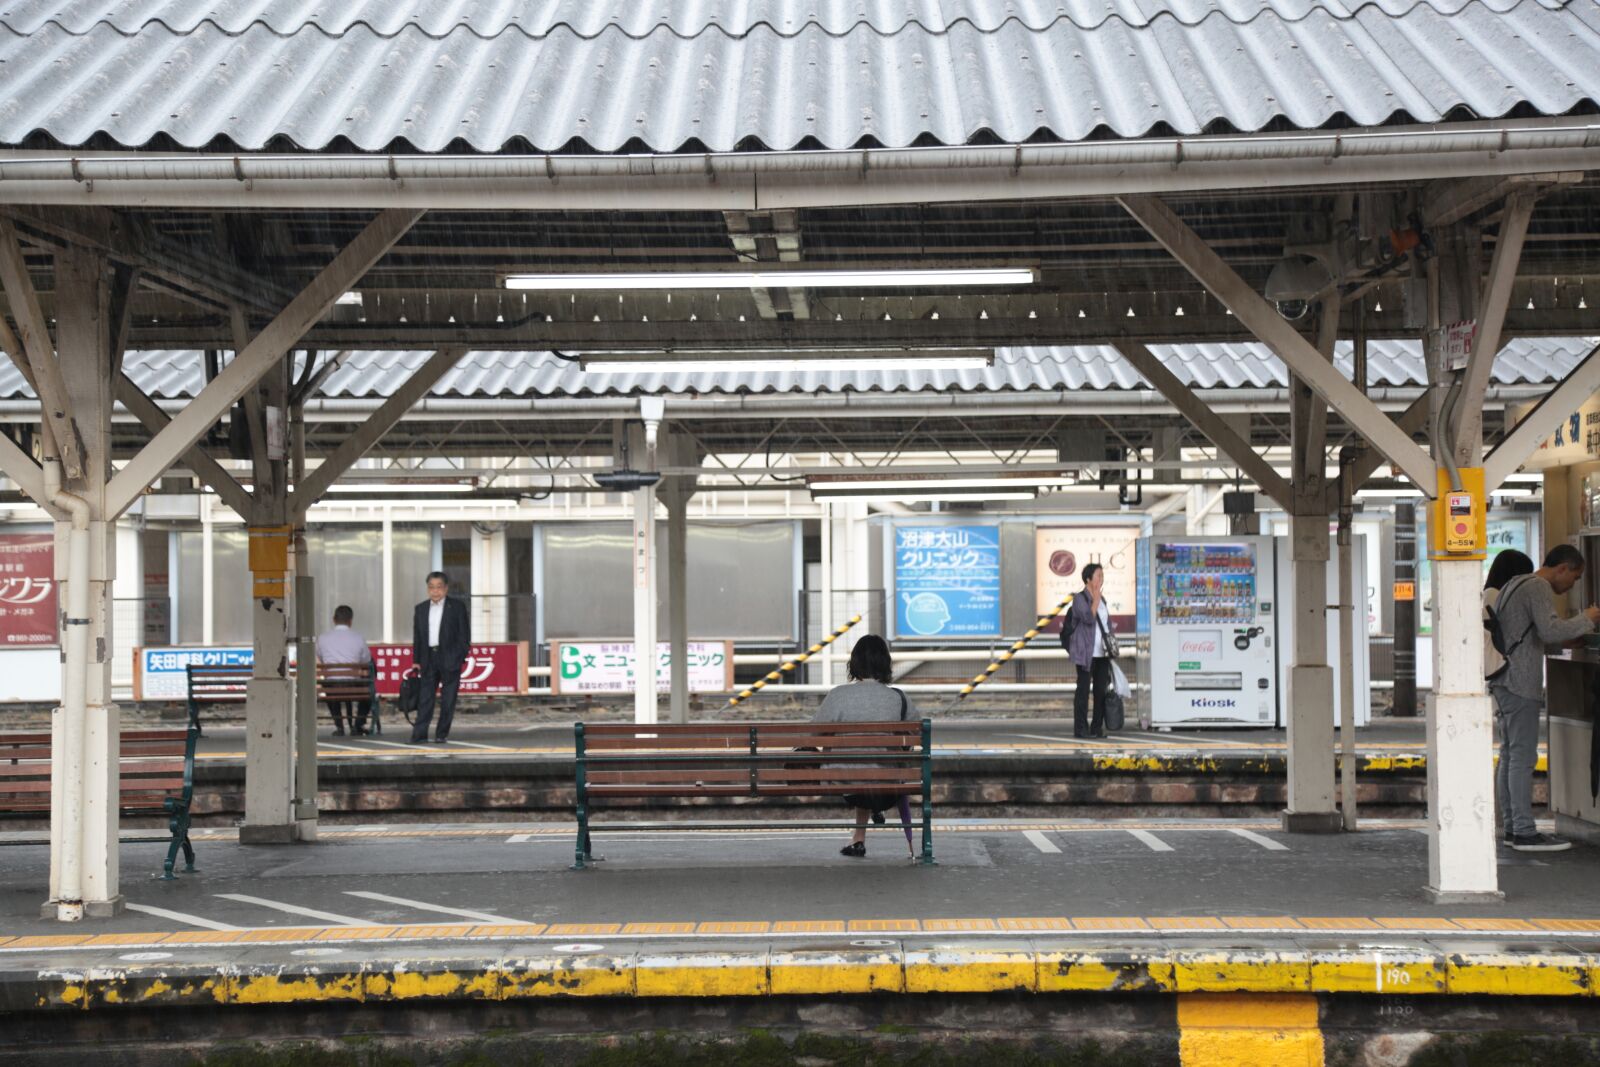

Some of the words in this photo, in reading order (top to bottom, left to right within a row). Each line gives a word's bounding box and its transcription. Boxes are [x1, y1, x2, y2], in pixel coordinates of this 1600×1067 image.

[902, 530, 969, 547] 沼津大山
[902, 551, 979, 567] クリニック
[150, 652, 254, 670] 矢田眼科クリニッ
[583, 654, 596, 668] 文
[604, 653, 724, 668] ニュークニック
[1191, 698, 1236, 708] Kiosk
[1386, 968, 1411, 986] 190
